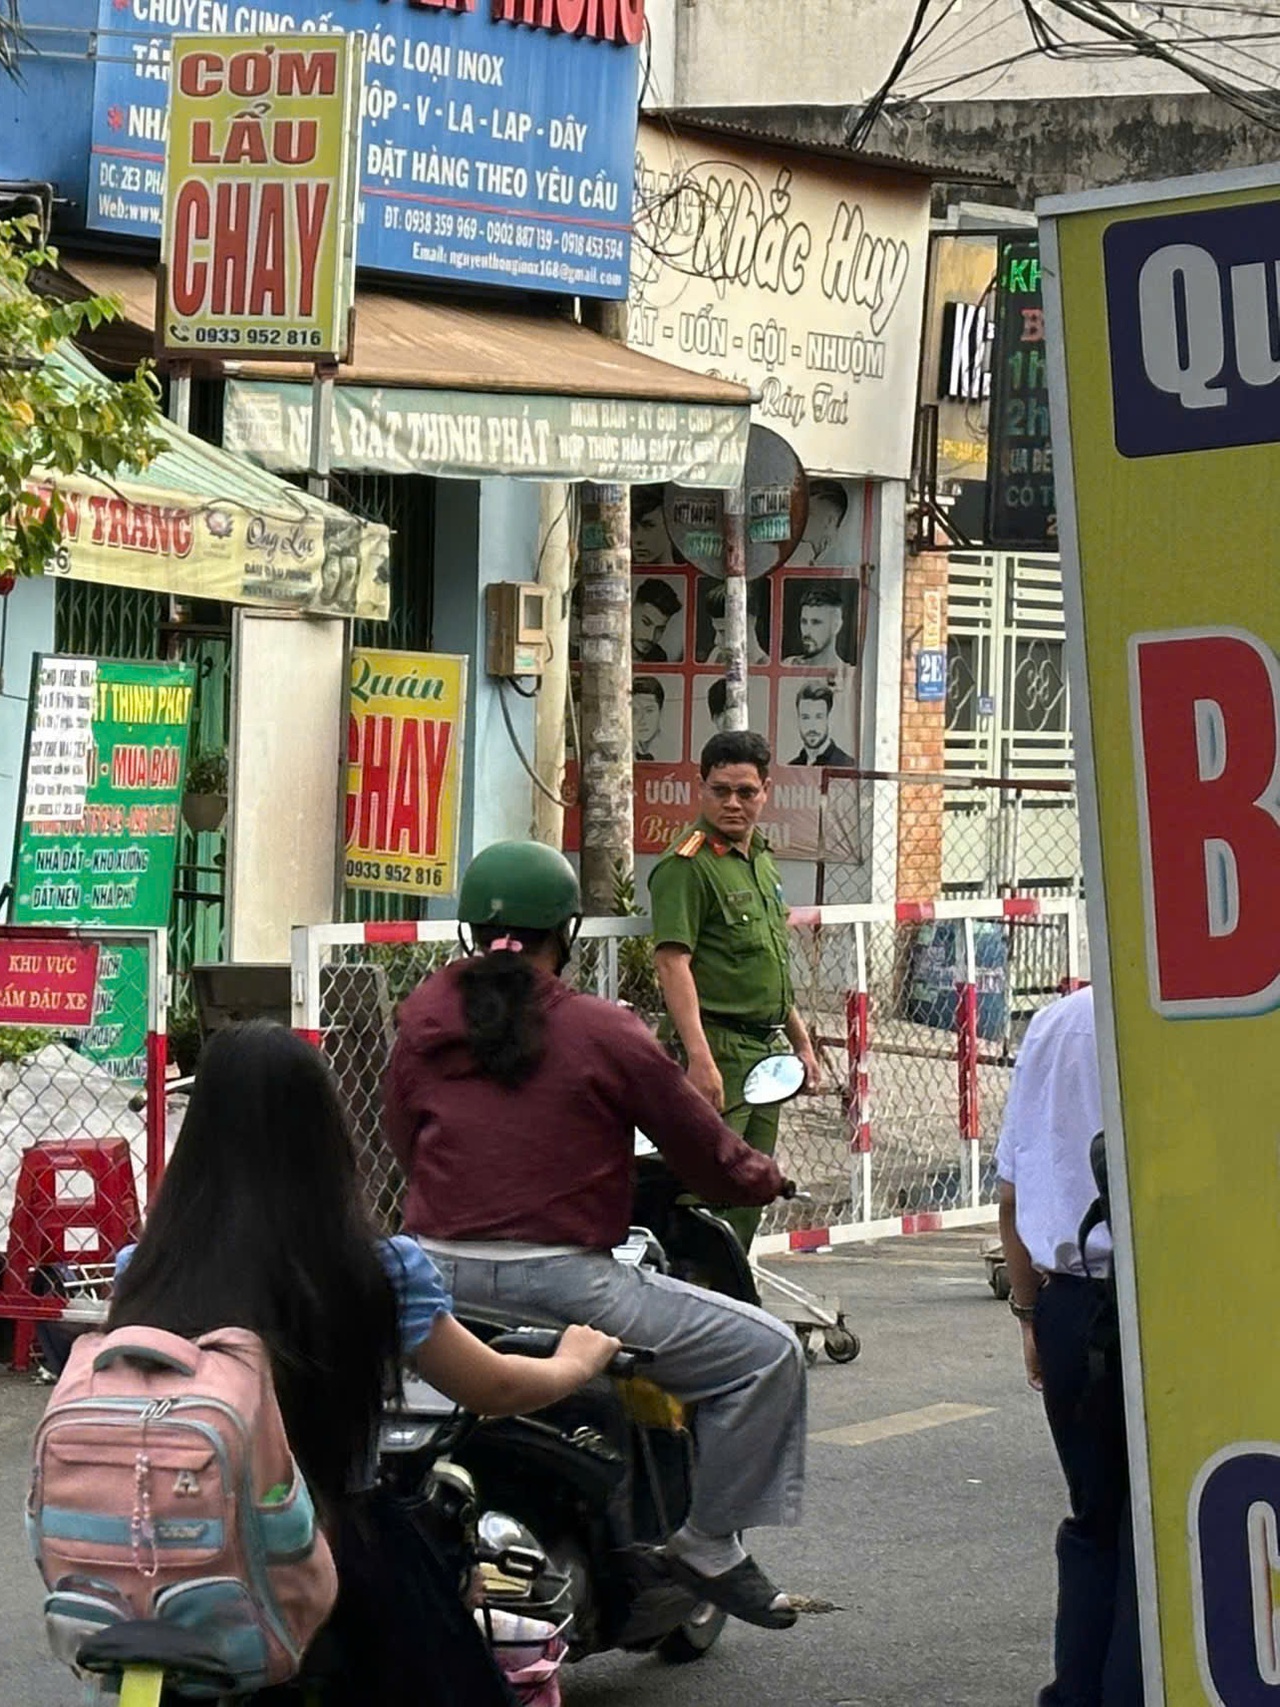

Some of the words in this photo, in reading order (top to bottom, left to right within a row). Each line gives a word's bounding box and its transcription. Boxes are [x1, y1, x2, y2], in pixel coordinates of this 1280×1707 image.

[179, 45, 338, 97] CƠM
[403, 39, 451, 83] LOẠI
[457, 51, 504, 87] INOX
[192, 102, 319, 164] LẨU
[416, 95, 431, 126] V
[448, 101, 475, 135] LA
[492, 108, 532, 143] LAP
[549, 115, 588, 153] DÂY
[367, 139, 407, 186] ĐẶT
[412, 144, 470, 190] HÀNG
[475, 162, 528, 199] THEO
[535, 166, 575, 206] YÊU
[579, 169, 619, 211] CẦU
[173, 179, 331, 317] CHAY
[405, 209, 432, 234] 0938
[433, 213, 454, 237] 359
[456, 215, 478, 240] 969
[486, 220, 514, 246] 0902
[821, 200, 910, 337] Huy
[195, 326, 241, 344] 0933
[246, 328, 285, 345] 952
[287, 330, 322, 347] 816
[806, 331, 886, 383] NHUỘM
[487, 405, 551, 466] PHÁT
[350, 657, 445, 703] Quán
[111, 745, 148, 789] MUA
[149, 737, 181, 789] BÁN
[644, 773, 691, 806] UỐN
[346, 860, 381, 881] 0933
[385, 863, 412, 884] 952
[415, 868, 442, 887] 816
[8, 955, 42, 974] KHU
[46, 955, 78, 979] VỰC
[29, 987, 62, 1012] ĐẬU
[64, 992, 89, 1011] XE
